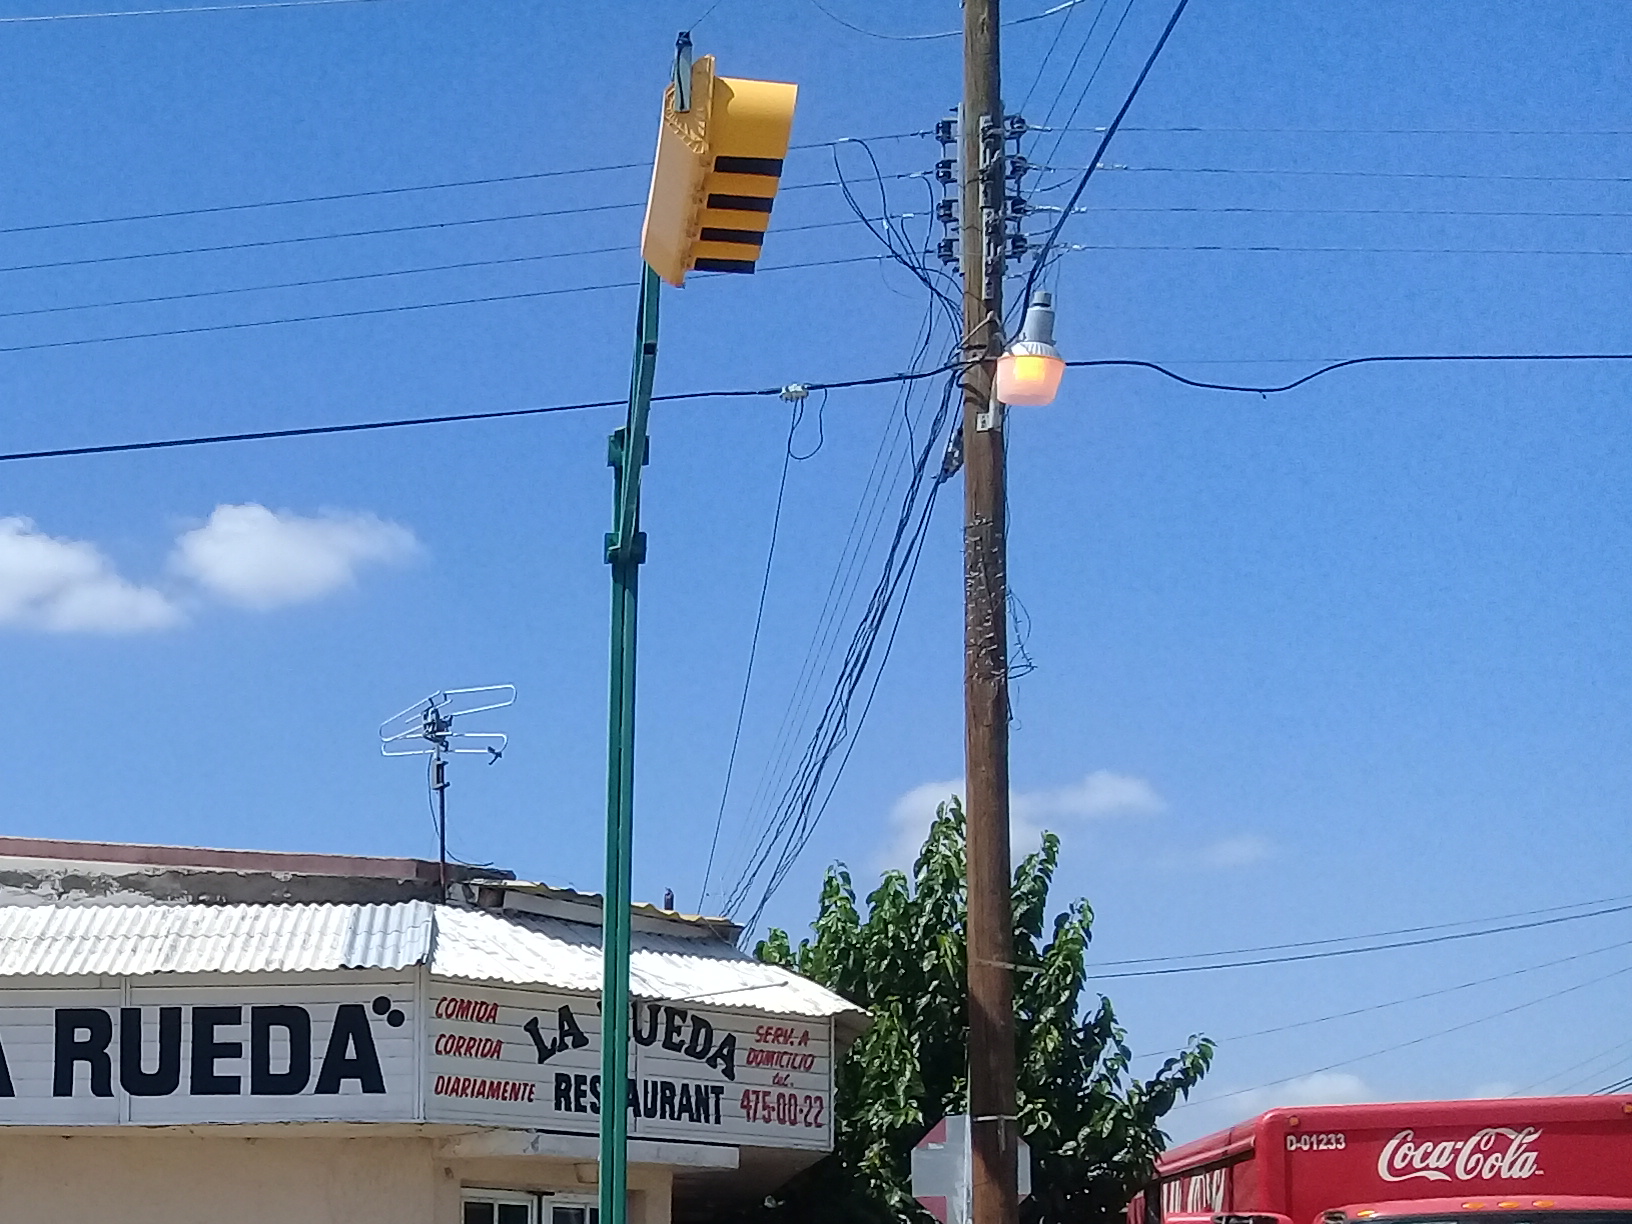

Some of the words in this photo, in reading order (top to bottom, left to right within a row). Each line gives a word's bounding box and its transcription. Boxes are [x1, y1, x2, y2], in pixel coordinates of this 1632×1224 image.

[434, 996, 499, 1024] COMIDA
[434, 1033, 504, 1060] CORRIDA
[523, 1004, 590, 1064] LA
[597, 1000, 737, 1081] UEDA
[798, 1029, 810, 1047] A
[746, 1047, 816, 1071] DOMICILIO
[434, 1075, 536, 1103] DIARIAMENTE
[554, 1073, 725, 1125] RESAURANT
[1286, 1133, 1346, 1150] D-01233
[1378, 1127, 1544, 1182] Coca-Cola
